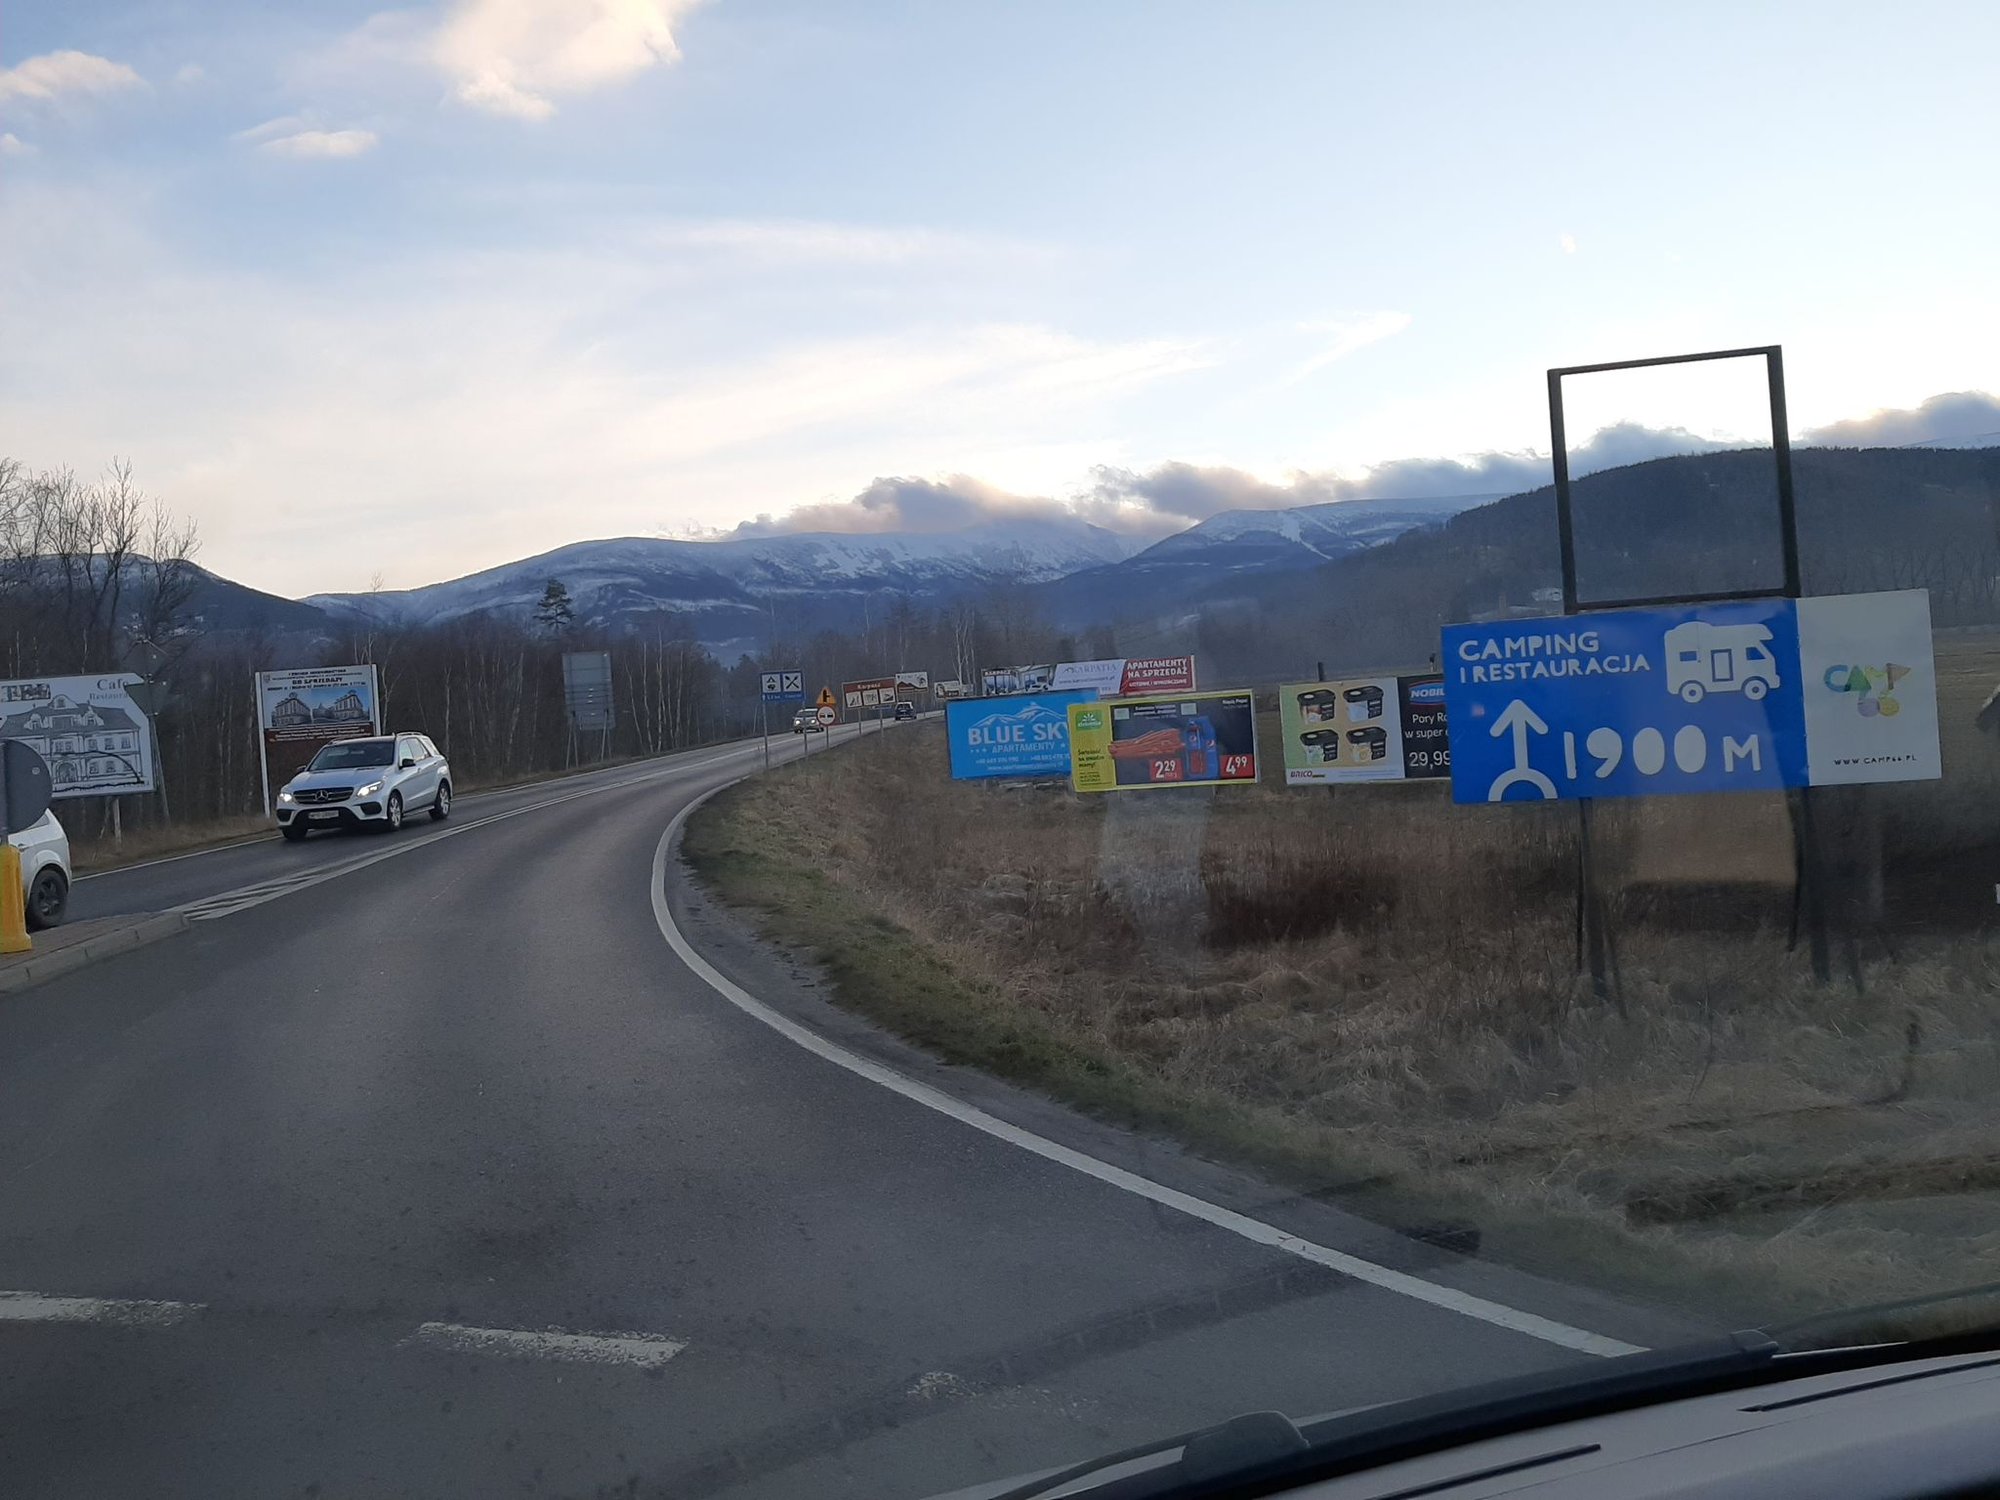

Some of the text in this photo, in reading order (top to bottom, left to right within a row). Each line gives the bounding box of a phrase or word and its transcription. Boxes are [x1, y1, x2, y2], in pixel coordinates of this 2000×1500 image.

[1458, 631, 1600, 662] CAMPING
[1127, 658, 1188, 670] APARTAMENTY
[1459, 653, 1651, 684] I RESTAURACJA
[1127, 667, 1188, 679] NA SPRZEDAŻ
[1412, 713, 1435, 725] Pory
[967, 724, 1026, 746] BLUE
[1416, 728, 1444, 740] super
[991, 741, 1055, 754] APARTAMENTY
[1563, 724, 1761, 780] 1900 M
[1408, 750, 1451, 770] 29,99
